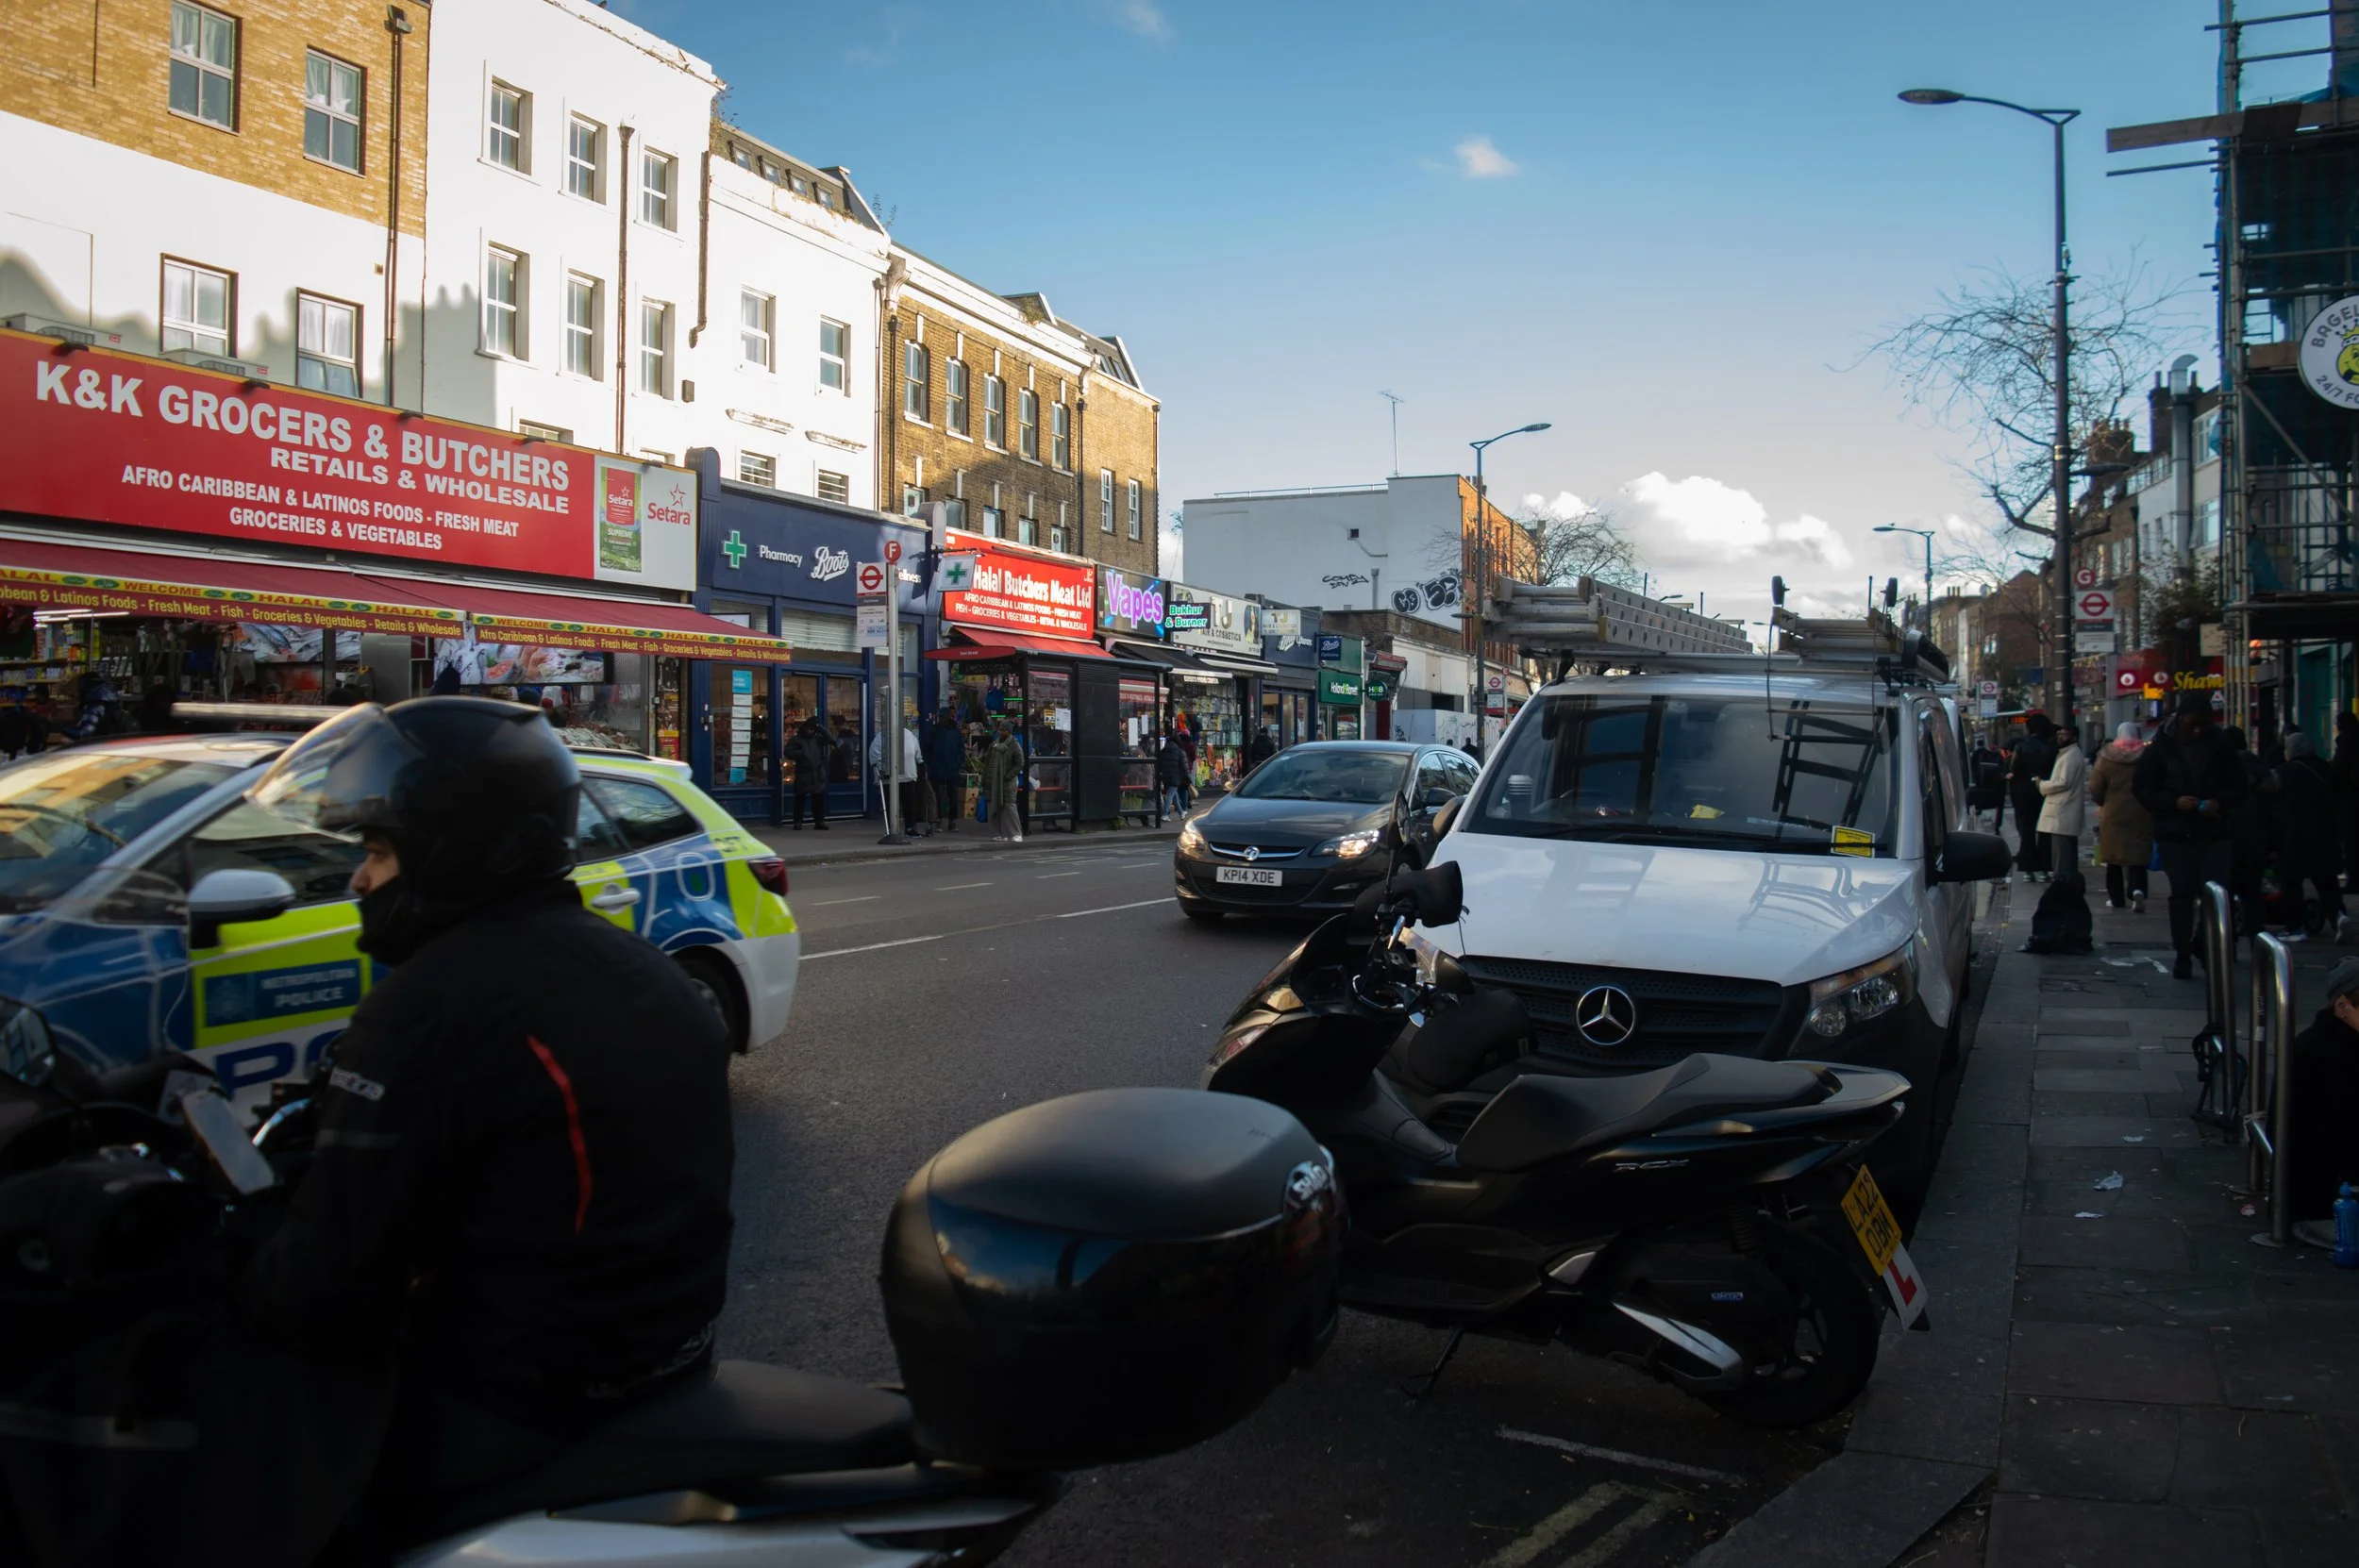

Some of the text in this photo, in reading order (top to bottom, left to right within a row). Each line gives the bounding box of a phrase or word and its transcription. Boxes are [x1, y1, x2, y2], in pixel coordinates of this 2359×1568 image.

[2316, 375, 2343, 397] 24/7
[37, 360, 569, 492] K&K GROCERS & BUTCHERS
[271, 447, 569, 514] RETAILS & WHOLESALE
[122, 465, 173, 490] AFRO
[178, 474, 280, 505] CARIBBEAN
[285, 489, 298, 507] &
[304, 491, 370, 516] LATINOS
[374, 501, 424, 525] FOODS
[435, 510, 480, 533] FRESH
[483, 516, 519, 538] MEAT
[609, 494, 633, 507] Setara
[647, 503, 692, 525] Setara
[229, 507, 443, 550] GROCERIES & VEGETABLES
[759, 544, 921, 584] Pharmacy Boots ellness
[888, 545, 896, 558] F
[125, 581, 201, 596] WELCOME
[259, 593, 325, 608] HALAL
[376, 605, 433, 617] HALAL
[964, 592, 979, 604] AFRO
[973, 565, 1092, 609] Halal Butchers Meat Ltd
[1106, 571, 1163, 629] Vapes
[54, 591, 98, 607] Latinos
[102, 594, 137, 609] Foods
[148, 599, 180, 613] Fresh
[183, 602, 210, 616] Meat
[221, 605, 243, 618] Fish
[252, 609, 302, 624] Groceries
[305, 610, 312, 624] &
[313, 613, 366, 629] Vegetables
[375, 618, 405, 631] Retails
[408, 621, 415, 632] &
[417, 623, 460, 637] Wholesale
[956, 603, 968, 613] FISH
[972, 606, 1000, 618] GROCERIES
[1006, 610, 1036, 624] VEGETABLES
[1165, 617, 1207, 627] & Burner
[1169, 605, 1203, 615] Bukhur
[1211, 596, 1232, 629] TJ
[479, 628, 497, 641] Afro
[498, 630, 537, 643] Caribbean
[545, 634, 573, 646] Latinos
[574, 637, 595, 648] Foods
[601, 639, 622, 649] Fresh
[622, 640, 639, 651] Meat
[644, 642, 659, 652] Fish
[663, 643, 694, 656] Groceries
[700, 646, 732, 659] Vegetables
[736, 648, 756, 659] Retails
[496, 618, 774, 647] WELCOME HALAL HALAL HALAL
[1223, 868, 1275, 884] KP14 XDE
[275, 987, 343, 1008] POLICE
